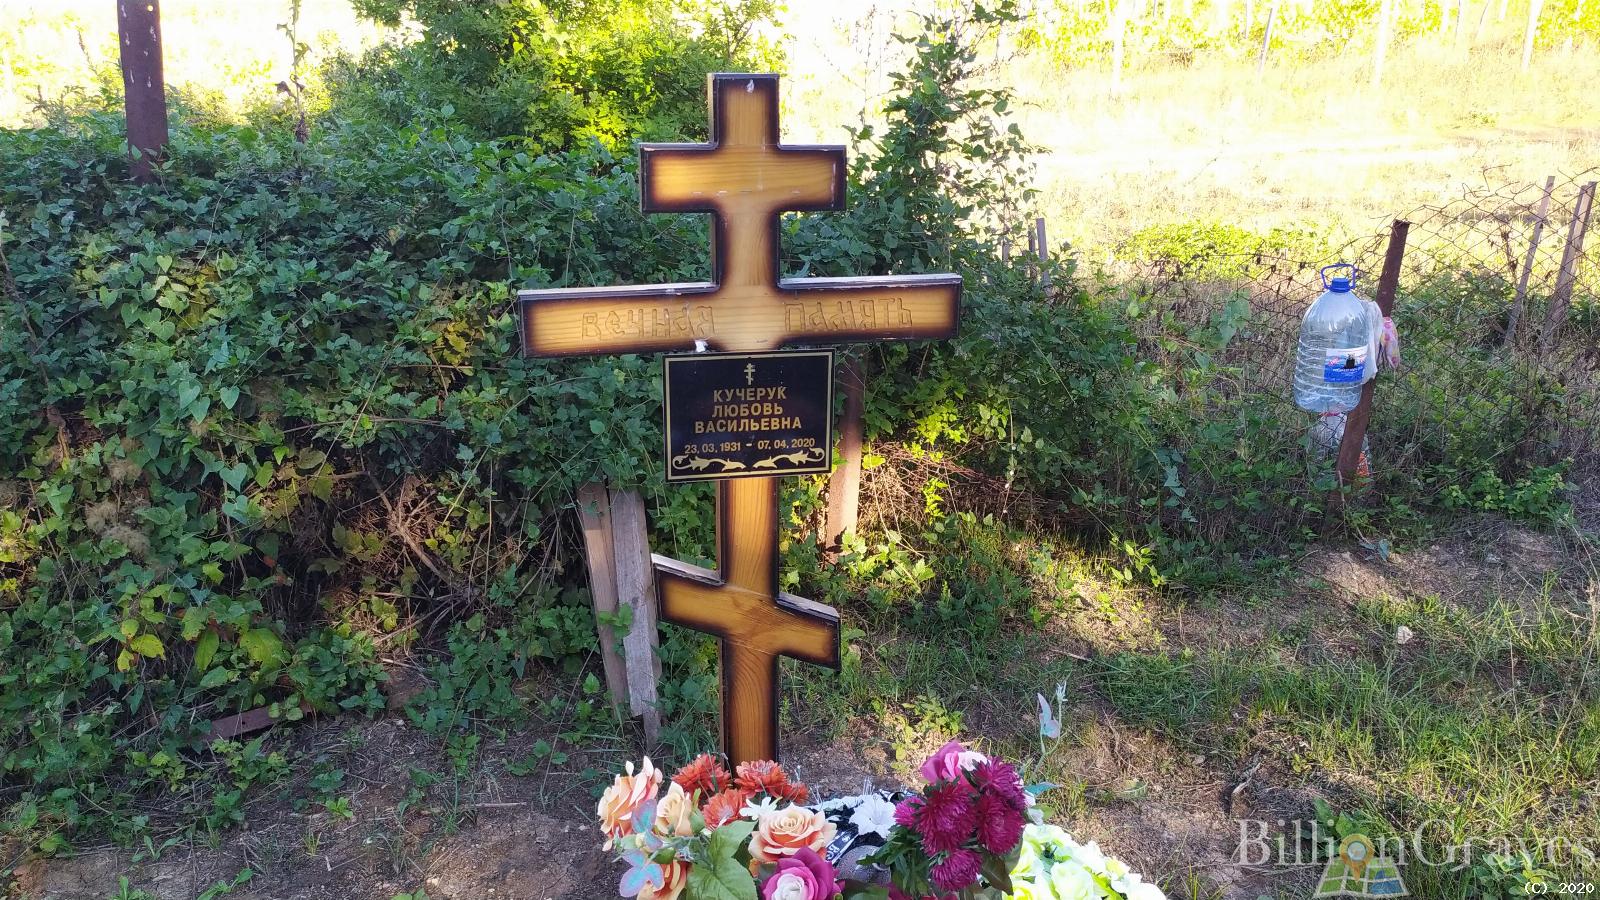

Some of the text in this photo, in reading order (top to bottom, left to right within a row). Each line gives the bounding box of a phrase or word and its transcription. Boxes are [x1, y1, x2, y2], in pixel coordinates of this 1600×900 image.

[713, 386, 787, 402] КУЧЕРУК
[712, 402, 783, 418] ЛЮБОВЬ
[695, 416, 802, 434] ВАСИЛЬЕВНА
